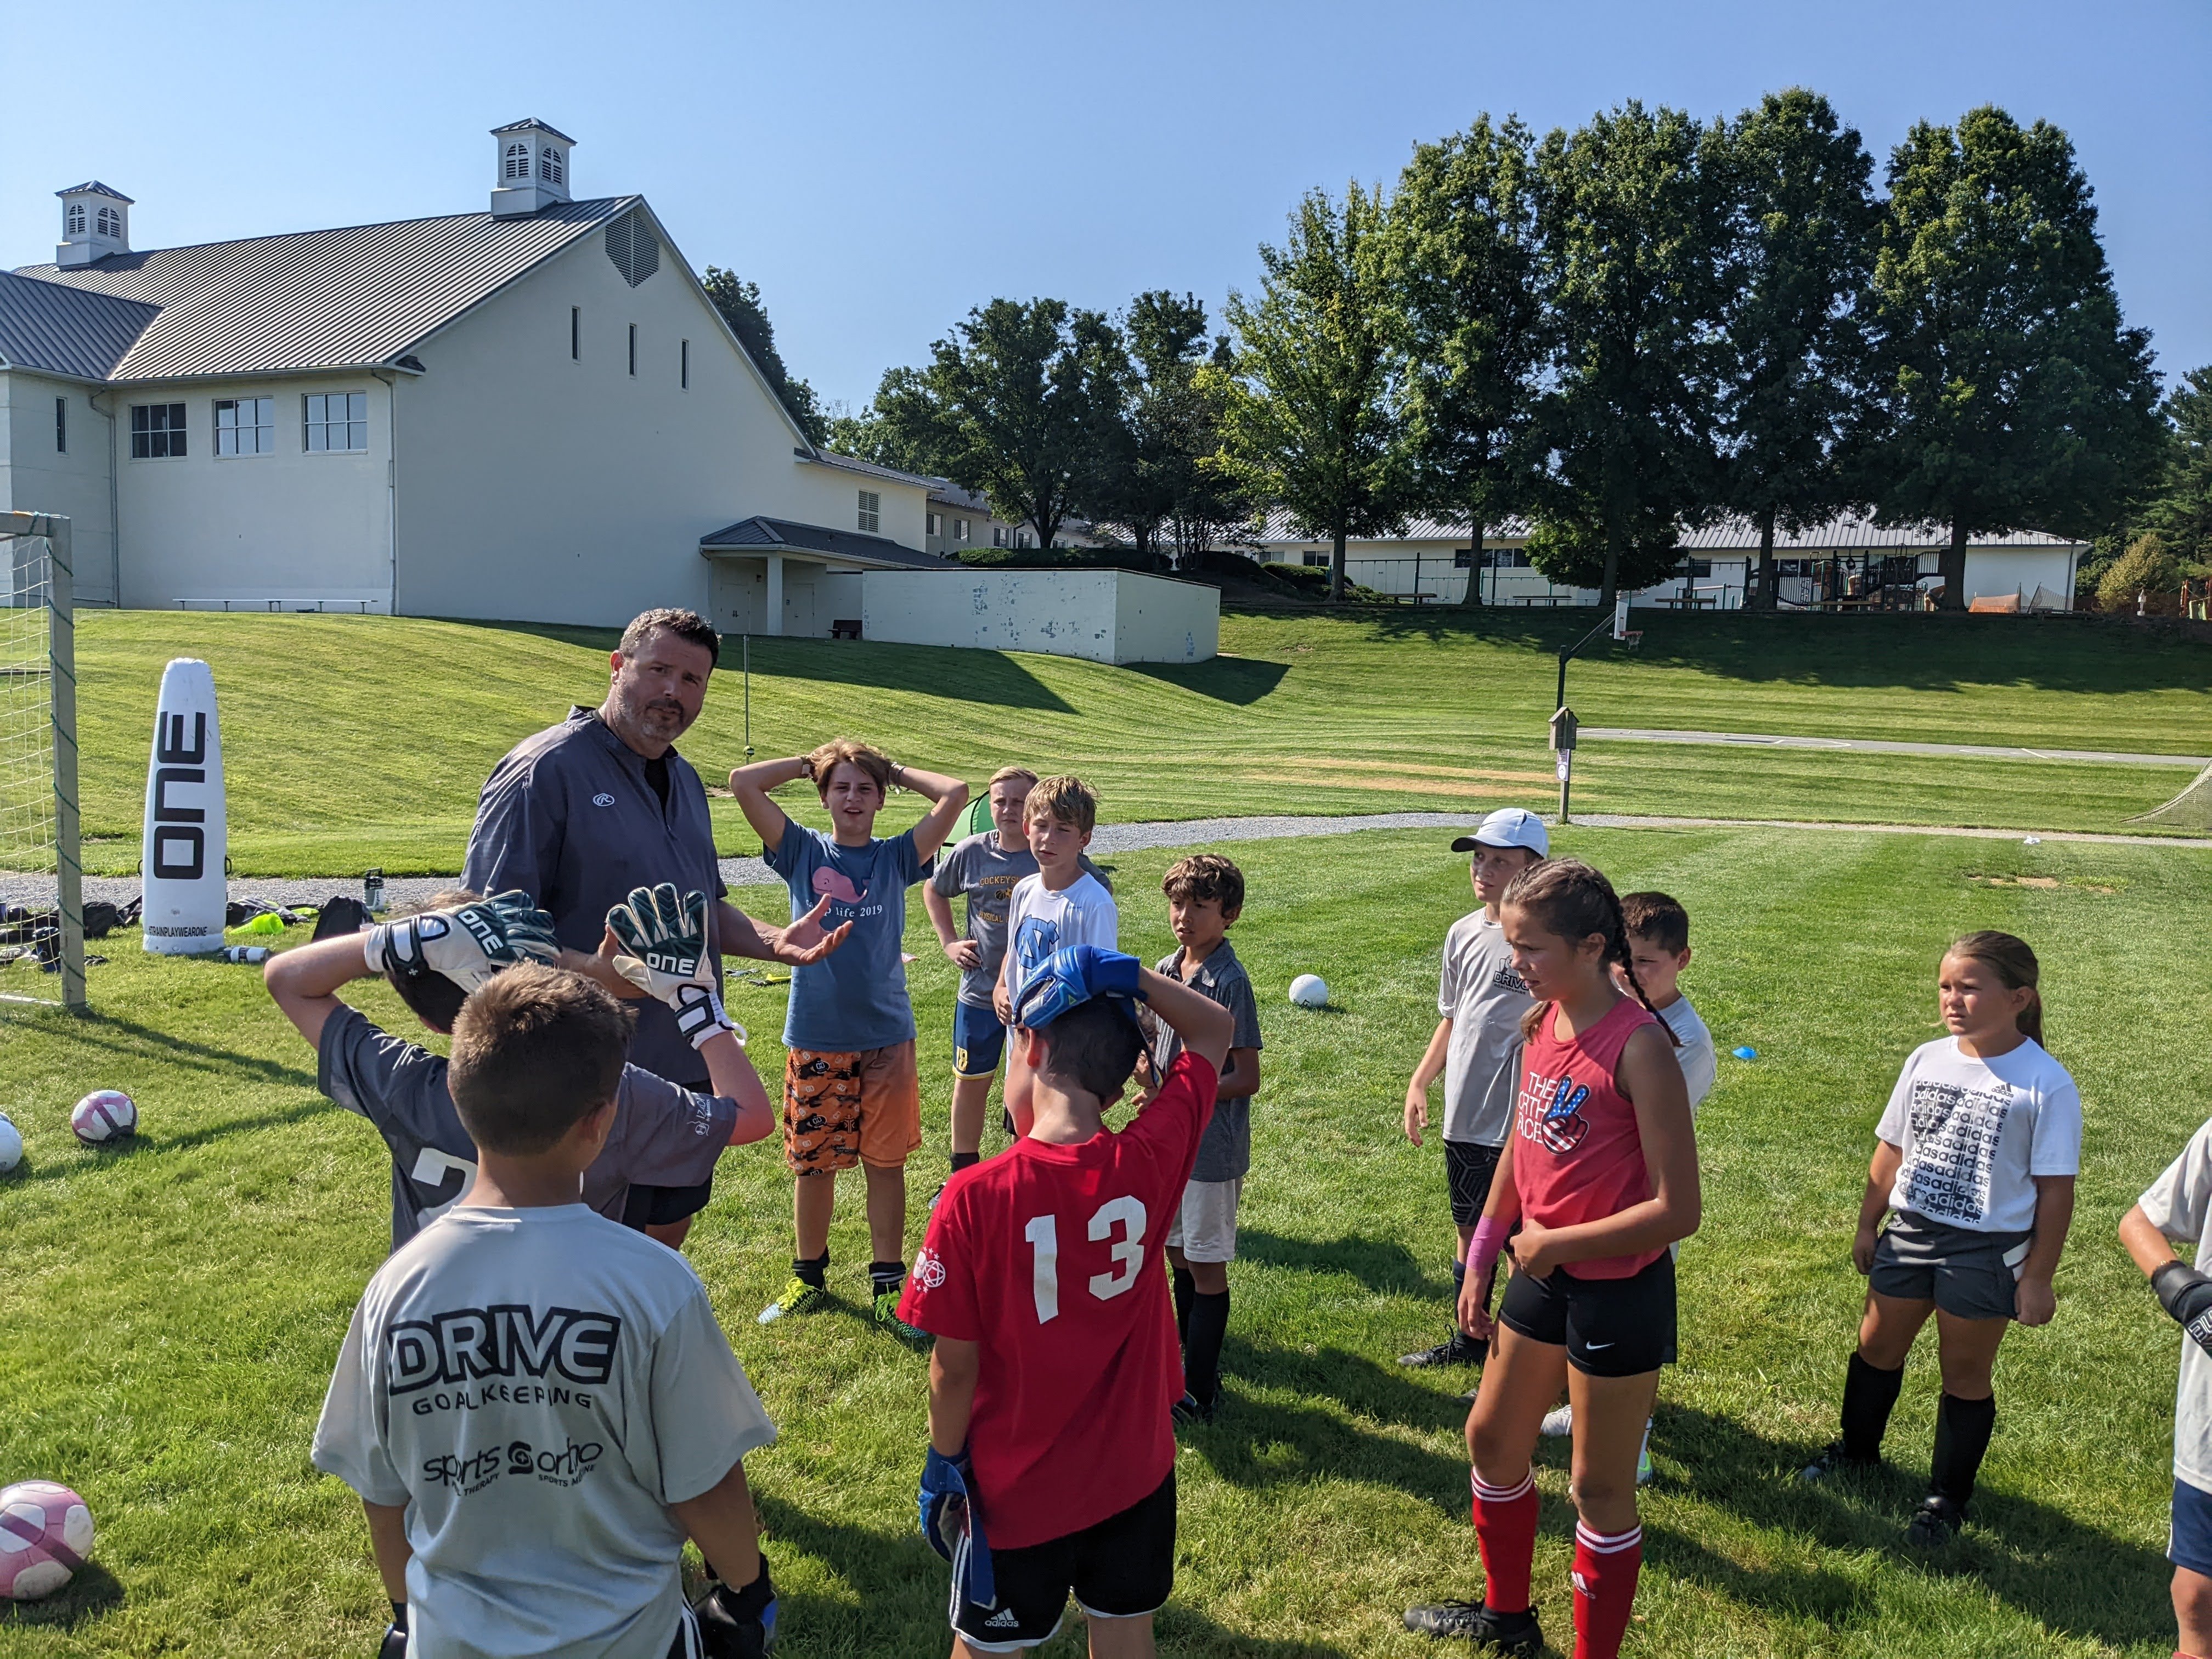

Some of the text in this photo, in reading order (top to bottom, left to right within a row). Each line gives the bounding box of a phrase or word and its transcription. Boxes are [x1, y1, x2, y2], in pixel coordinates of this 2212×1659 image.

[153, 711, 206, 880] ONE
[980, 876, 1019, 886] COCKEYS
[836, 907, 855, 917] life
[860, 905, 883, 917] 2019
[458, 910, 504, 955] ONE
[646, 952, 695, 975] ONE
[956, 1046, 968, 1071] 18
[1528, 1071, 1558, 1101] THE
[1991, 1088, 2014, 1098] adidas
[1025, 1194, 1147, 1325] 13
[387, 1304, 621, 1396] DRIVE
[412, 1383, 592, 1415] GOALKEEPING
[538, 1474, 568, 1487] SPORTS
